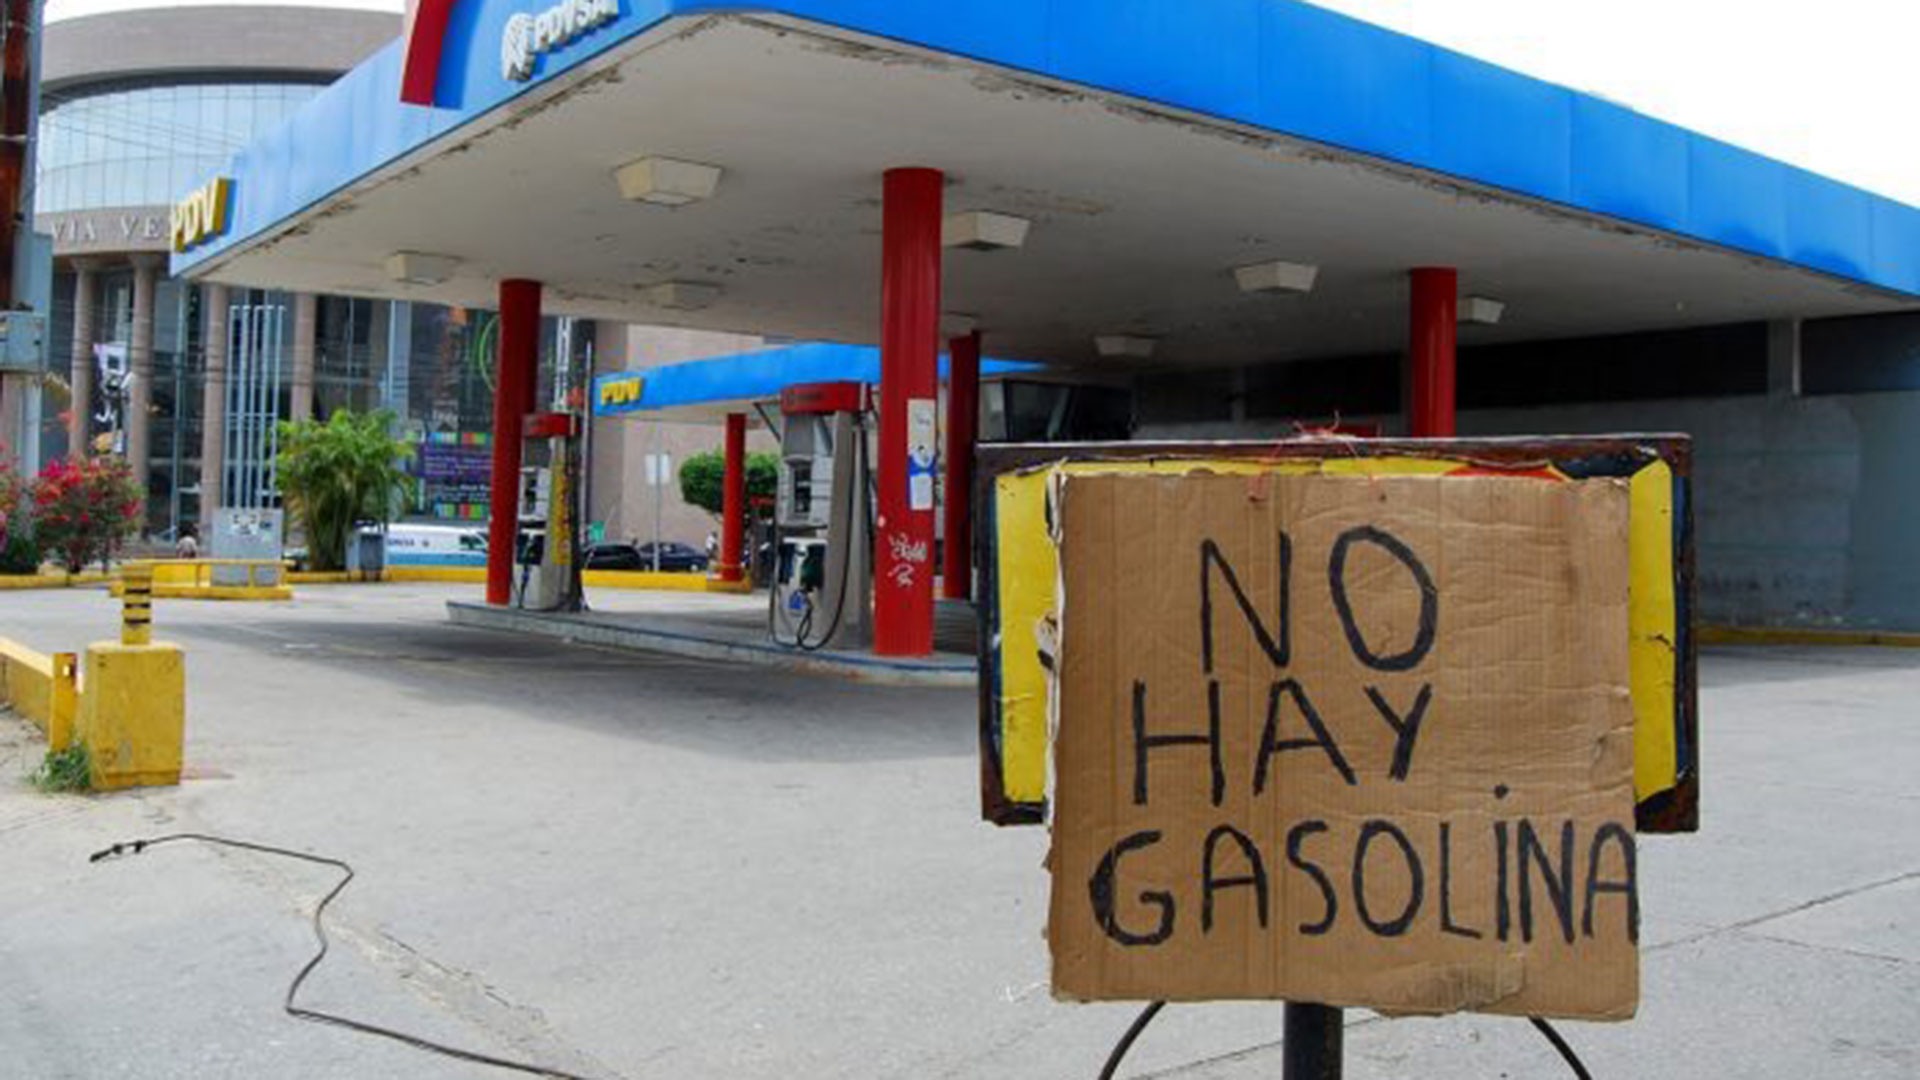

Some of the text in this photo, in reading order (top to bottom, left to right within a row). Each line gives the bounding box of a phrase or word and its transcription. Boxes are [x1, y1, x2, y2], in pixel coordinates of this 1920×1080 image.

[171, 179, 226, 252] PDV
[601, 377, 643, 406] PDV
[1200, 526, 1437, 675] NO
[1132, 677, 1431, 807] HAY
